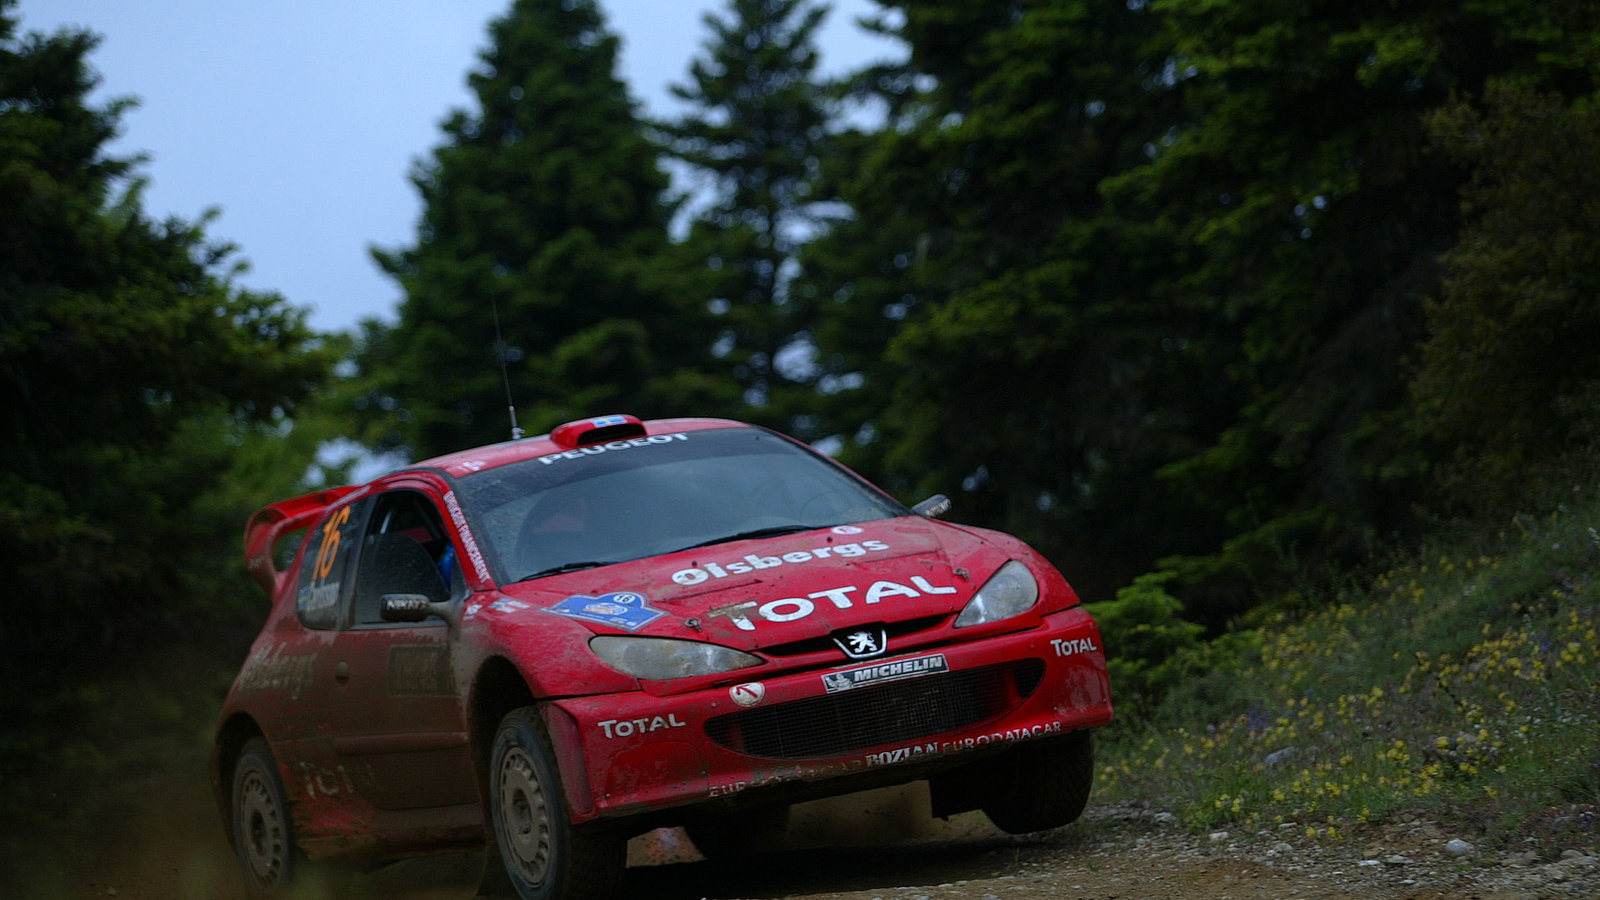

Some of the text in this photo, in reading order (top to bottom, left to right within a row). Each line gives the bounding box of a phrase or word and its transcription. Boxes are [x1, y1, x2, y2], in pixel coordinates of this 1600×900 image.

[538, 432, 688, 465] PEUGEOT
[311, 505, 351, 581] 16
[672, 539, 889, 586] Olsbergs
[617, 594, 632, 603] 16
[708, 575, 957, 632] TOTAL
[1050, 637, 1097, 657] TOTAL
[853, 656, 943, 682] MICHELIN
[598, 713, 686, 739] TOTAL
[865, 741, 939, 767] BOZIAN
